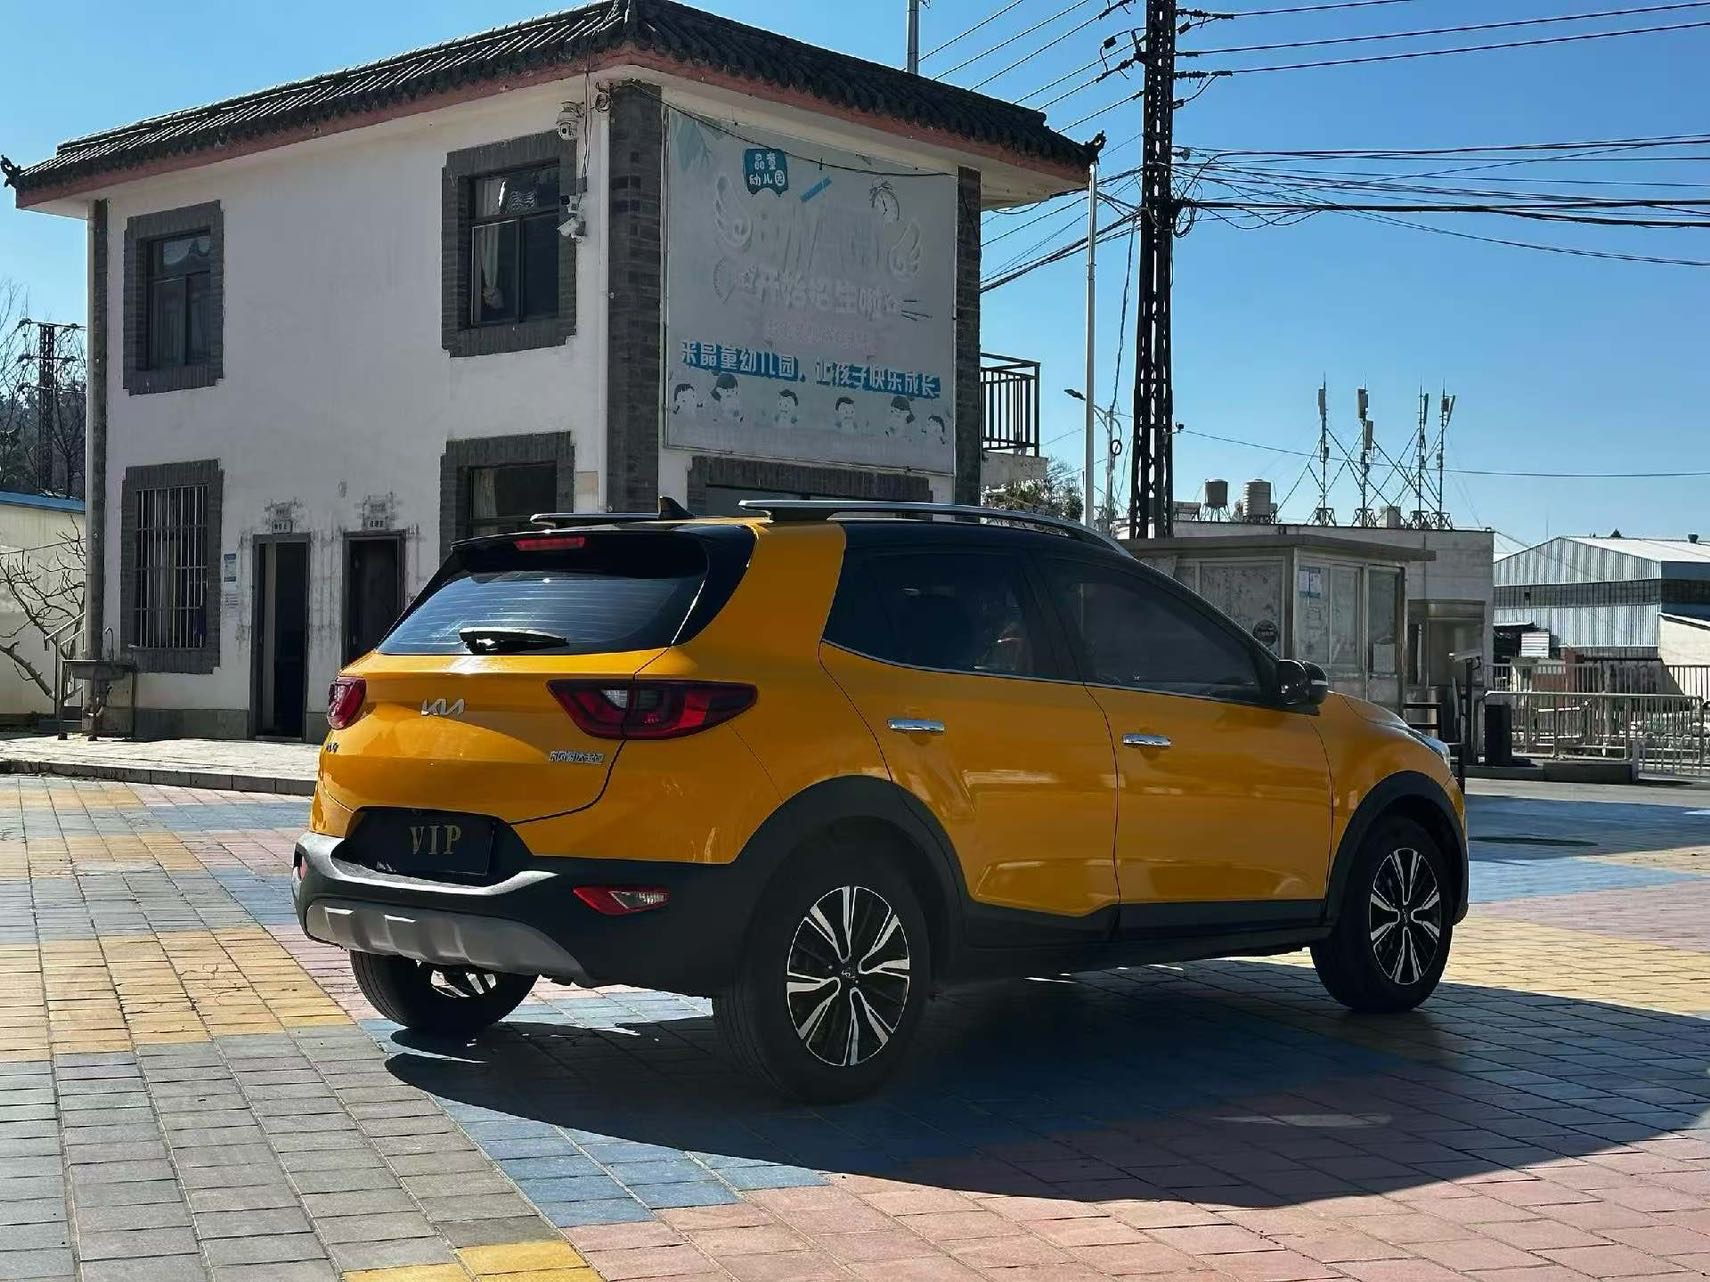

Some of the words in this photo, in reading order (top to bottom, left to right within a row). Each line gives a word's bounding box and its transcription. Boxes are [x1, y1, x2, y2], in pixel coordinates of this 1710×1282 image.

[749, 170, 785, 187] 幼儿园
[420, 698, 465, 717] KIA
[409, 825, 462, 855] VIP
